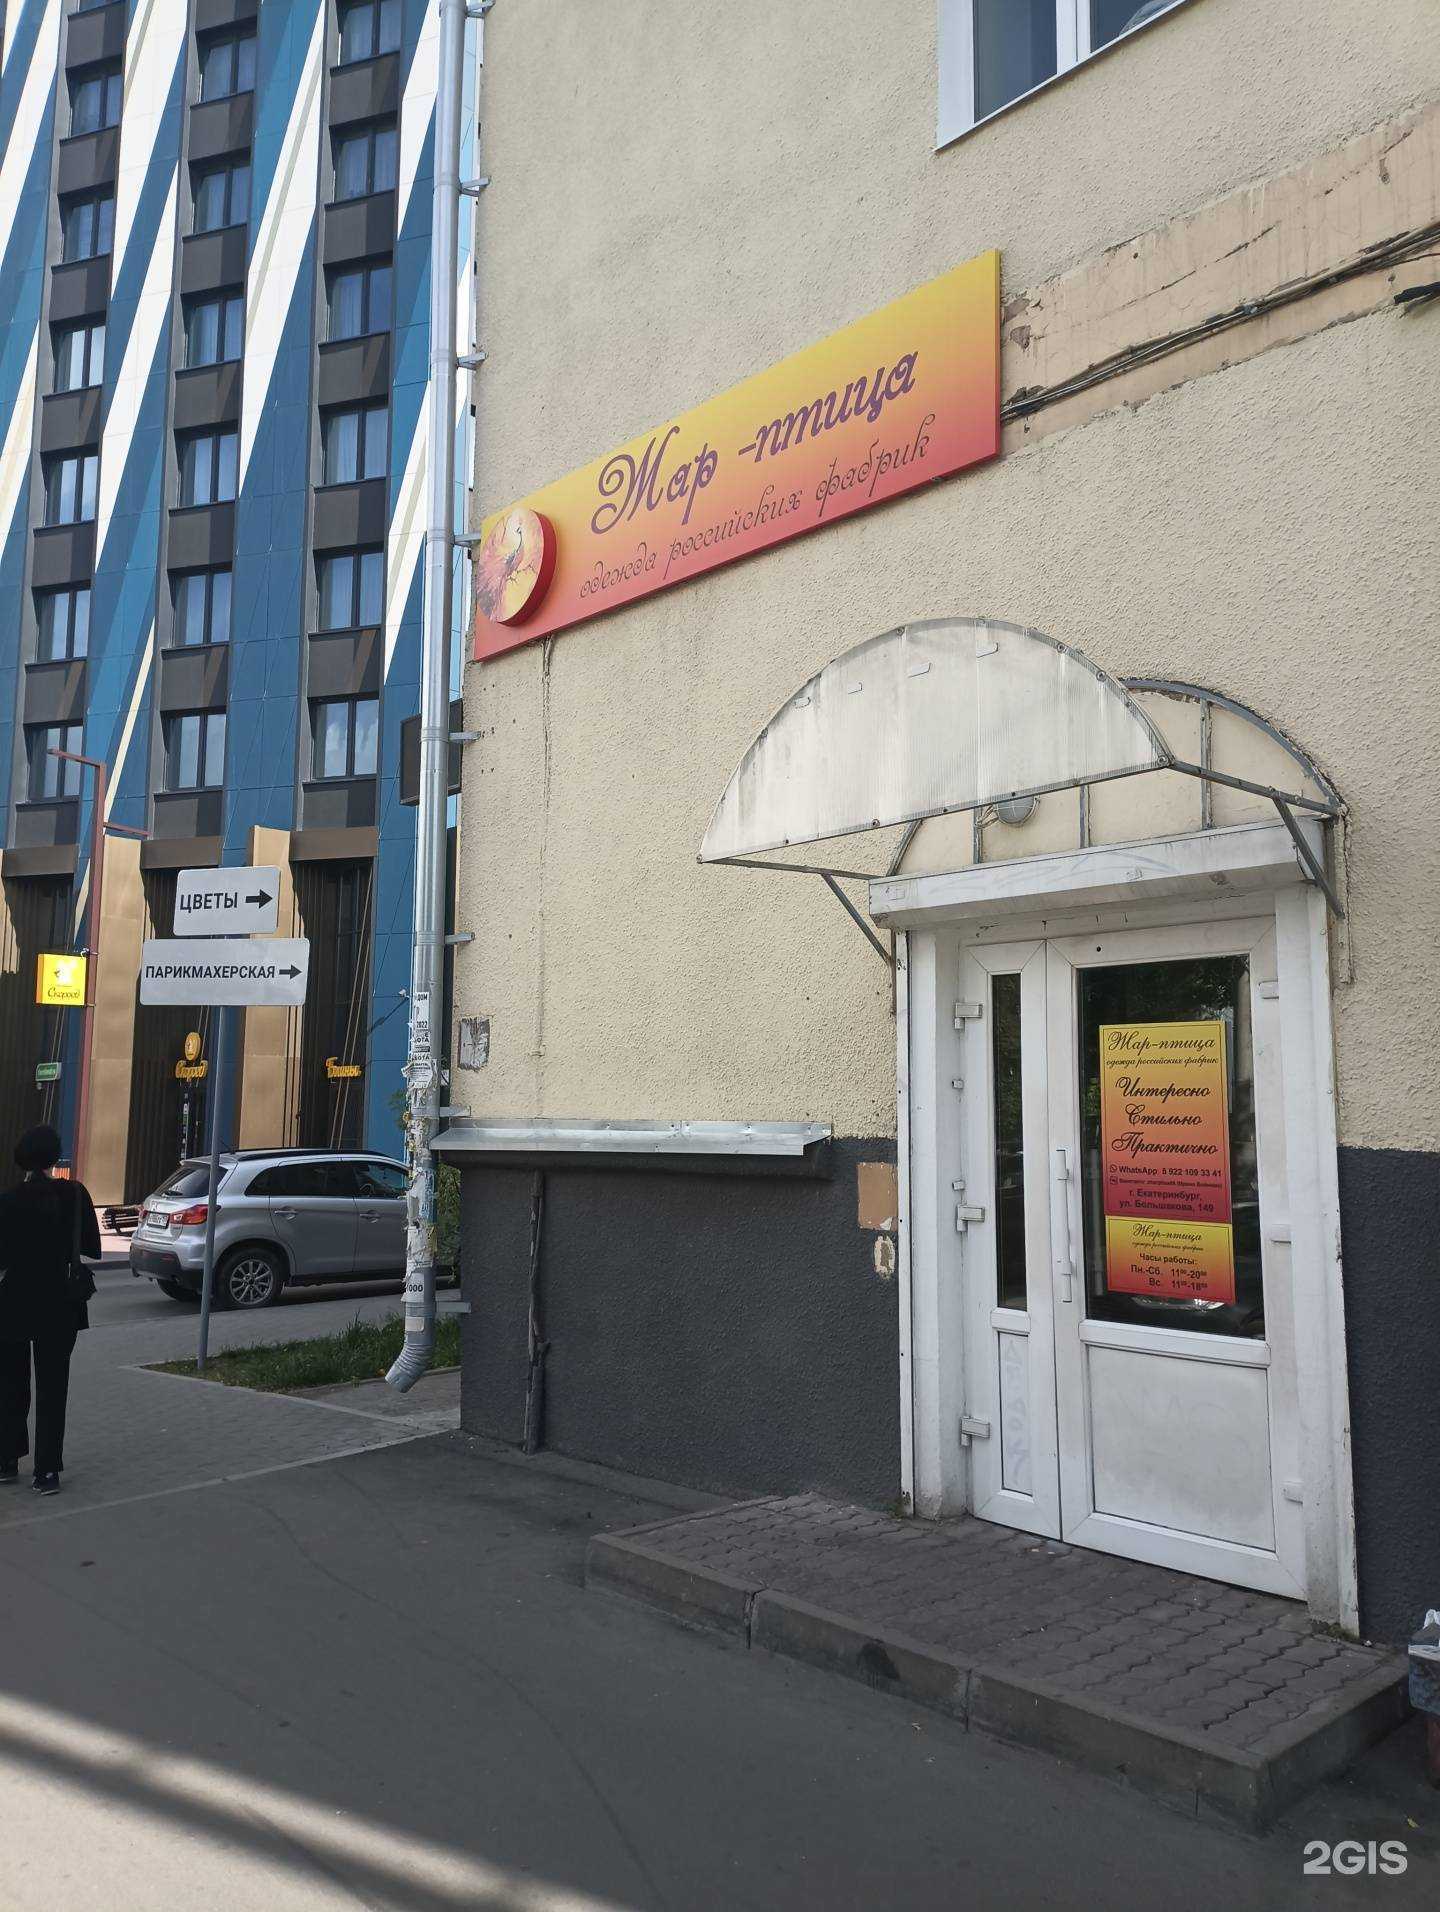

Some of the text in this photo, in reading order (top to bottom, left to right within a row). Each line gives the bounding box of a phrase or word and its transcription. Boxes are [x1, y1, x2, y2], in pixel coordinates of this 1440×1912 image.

[591, 425, 719, 535] Жар
[580, 413, 937, 599] одежда российских фабрик
[179, 892, 238, 914] ЦВЕТЫ
[145, 965, 276, 980] ПАРИКМАХЕРСКАЯ
[1107, 1030, 1216, 1056] Жар-птица
[1106, 1054, 1219, 1071] одежда российских фабрик
[1115, 1076, 1211, 1103] Интересно
[1125, 1103, 1202, 1126] Стильно
[1111, 1132, 1218, 1159] Практично
[1119, 1166, 1158, 1176] WhatsApp
[1169, 1168, 1182, 1176] 922
[1119, 1201, 1132, 1209] ул.
[1140, 1253, 1198, 1265] Часы работы:
